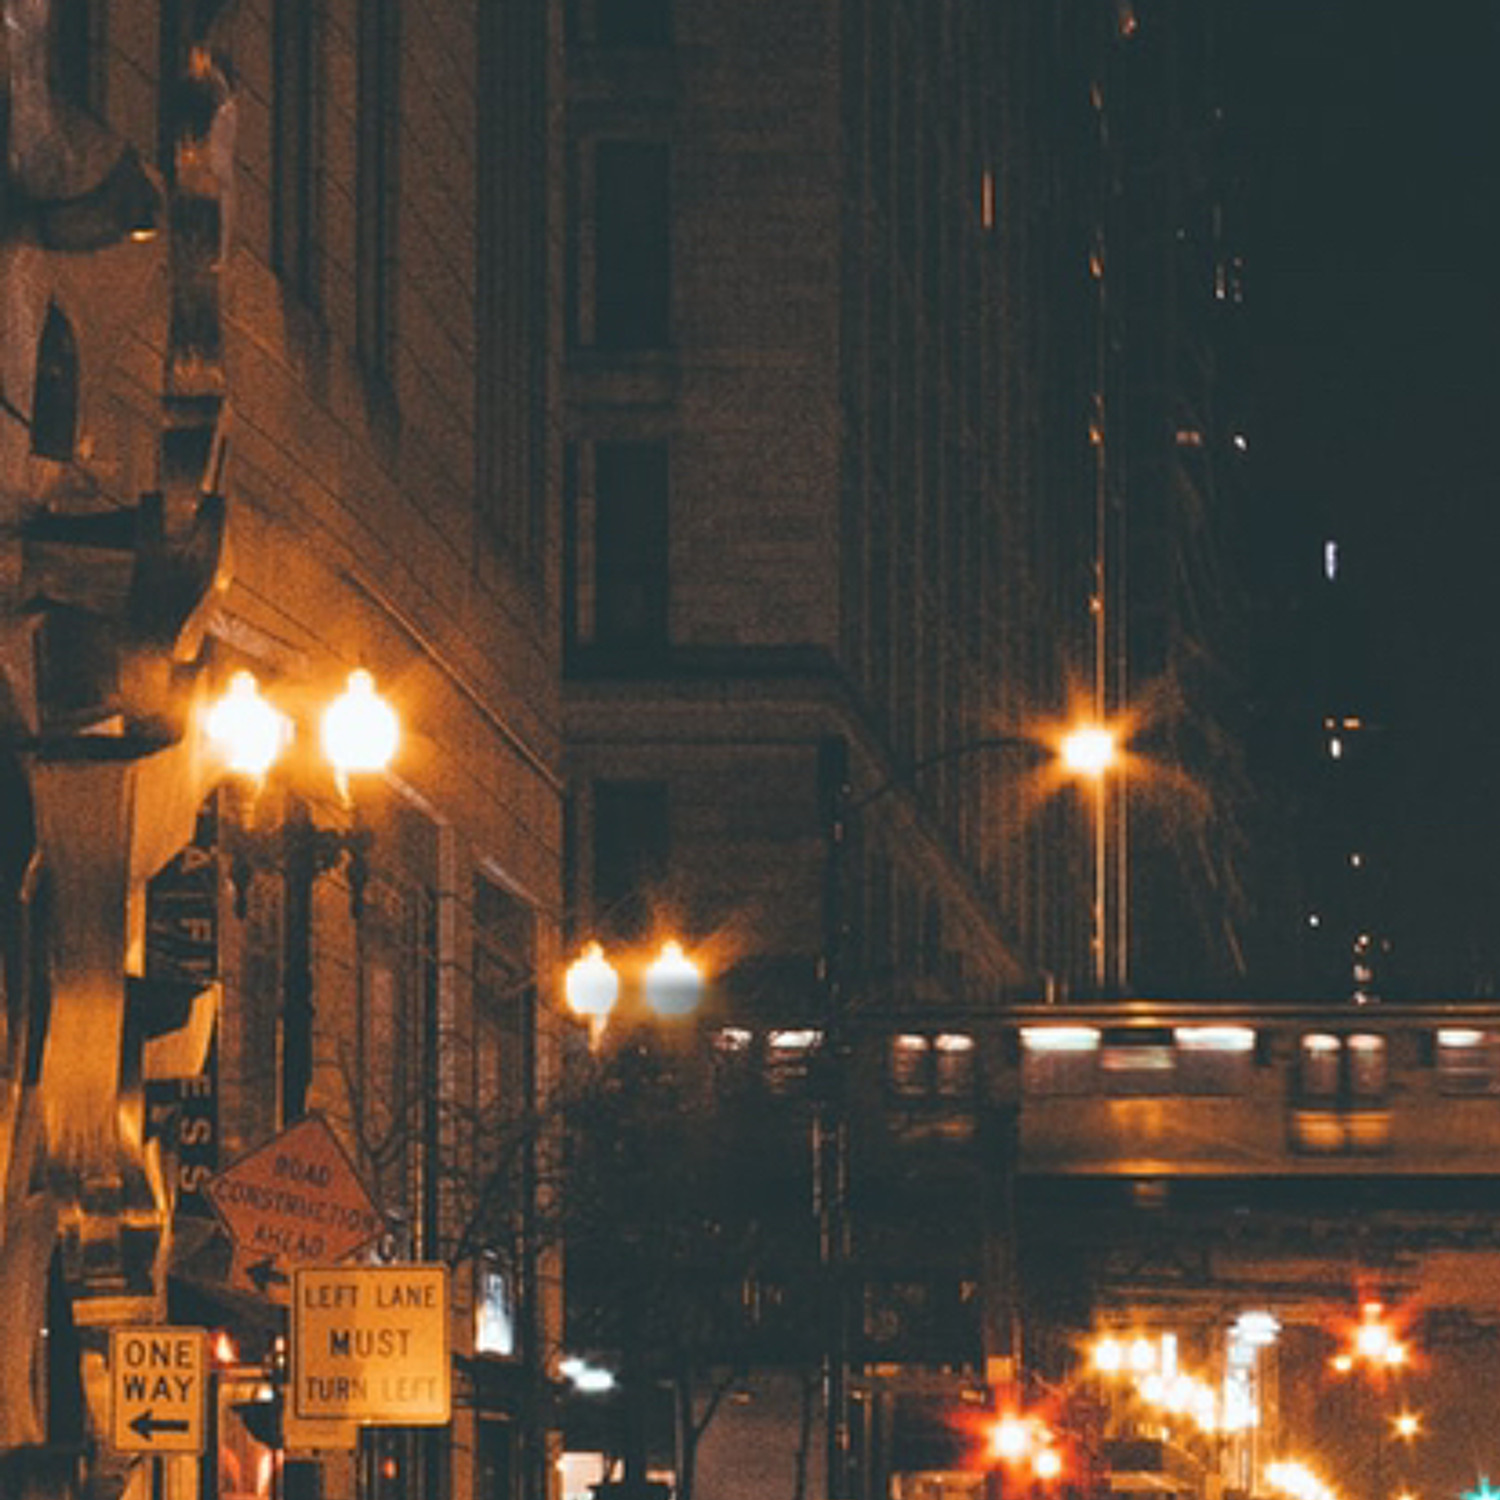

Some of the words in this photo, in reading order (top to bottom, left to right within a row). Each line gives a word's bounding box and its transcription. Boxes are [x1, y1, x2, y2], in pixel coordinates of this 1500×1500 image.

[272, 1153, 331, 1188] ROAD
[254, 1222, 325, 1260] AHEAD
[304, 1284, 359, 1309] LEFT
[376, 1284, 437, 1309] LANE
[124, 1339, 194, 1369] ONE
[329, 1328, 413, 1358] MUST
[123, 1374, 195, 1402] WAY
[305, 1375, 367, 1402] TURN
[383, 1376, 437, 1402] LEFT
